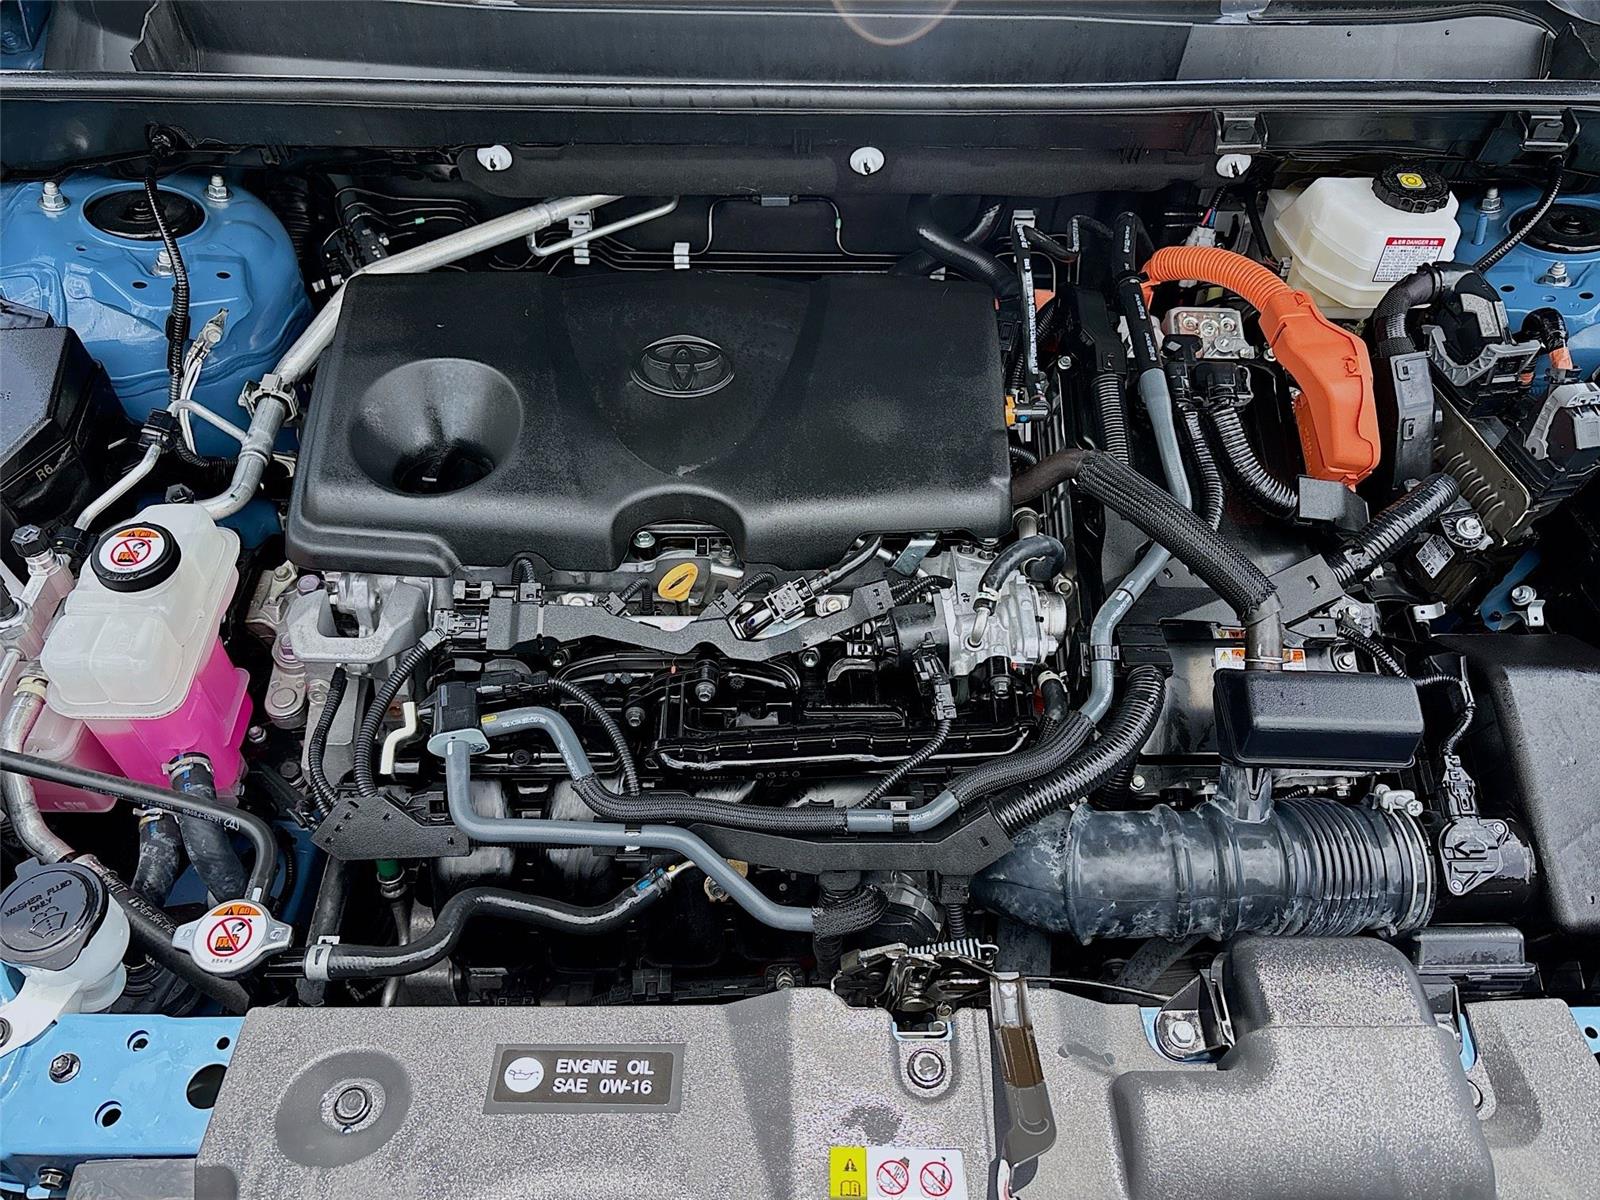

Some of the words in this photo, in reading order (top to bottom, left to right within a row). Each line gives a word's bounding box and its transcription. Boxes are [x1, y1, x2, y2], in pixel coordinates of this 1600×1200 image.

[35, 464, 54, 482] R6
[47, 879, 73, 896] FLUID
[29, 897, 52, 913] ONLY
[555, 1059, 618, 1074] ENGINE
[627, 1060, 655, 1075] OIL
[552, 1078, 588, 1093] SAE
[599, 1079, 652, 1094] 0W-16
